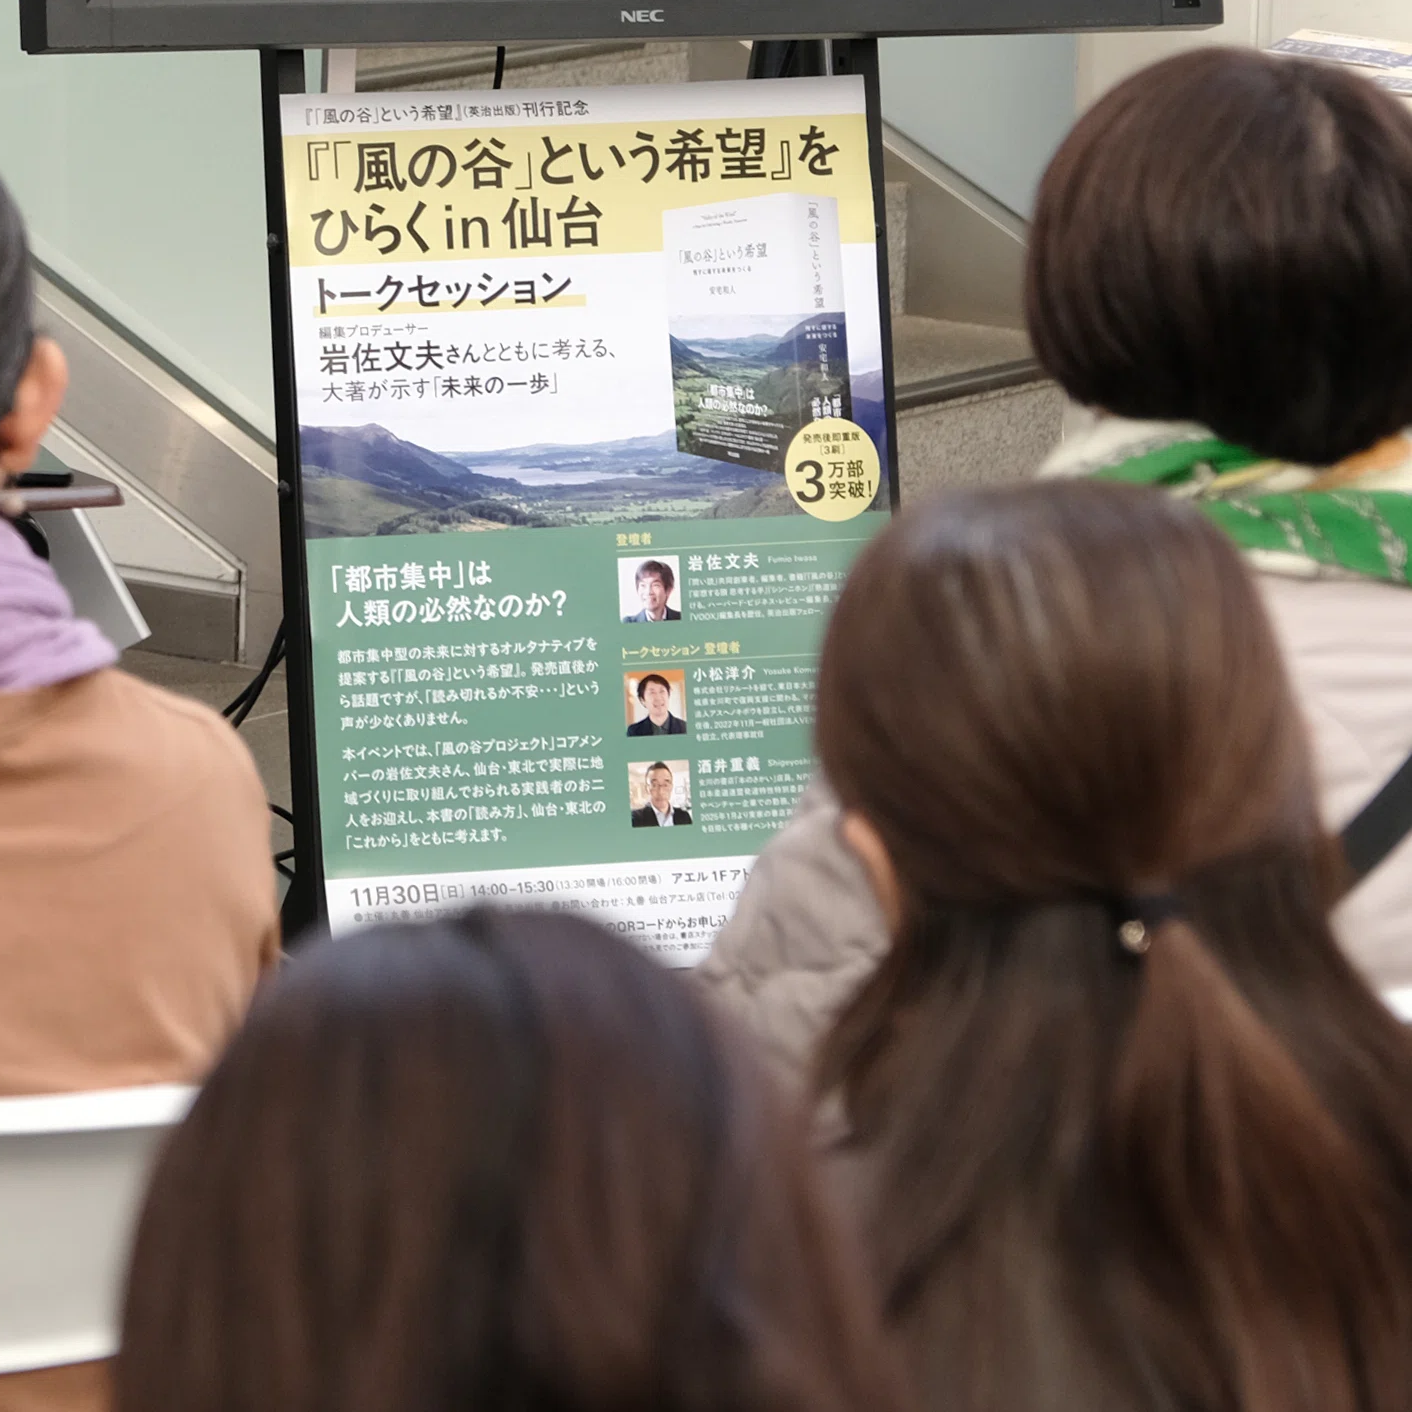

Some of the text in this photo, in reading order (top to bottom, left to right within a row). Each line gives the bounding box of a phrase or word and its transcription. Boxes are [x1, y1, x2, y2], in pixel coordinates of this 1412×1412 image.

[620, 10, 665, 24] NEC
[307, 124, 840, 194] 『「風の谷」という希望』を
[317, 272, 572, 315] トークセッション
[318, 323, 429, 340] 編集プロデューサー
[319, 338, 616, 376] 岩佐文夫さんとともに考える、
[322, 372, 558, 403] 大著が示す「未来の一歩」
[828, 459, 864, 479] 万部
[795, 459, 826, 503] 3
[688, 552, 760, 572] 岩佐文夫
[331, 560, 492, 593] 「都市集中」は
[336, 589, 567, 628] 人類の必然なのか?
[337, 637, 598, 665] 都市集中型の未来に対するオルタナティブを
[621, 644, 700, 659] トークセッション
[693, 665, 756, 682] 小松洋介
[340, 710, 469, 731] 声が少なくありません。
[697, 756, 761, 774] 酒井重義
[346, 828, 507, 850] 「これから」をともに考えます。
